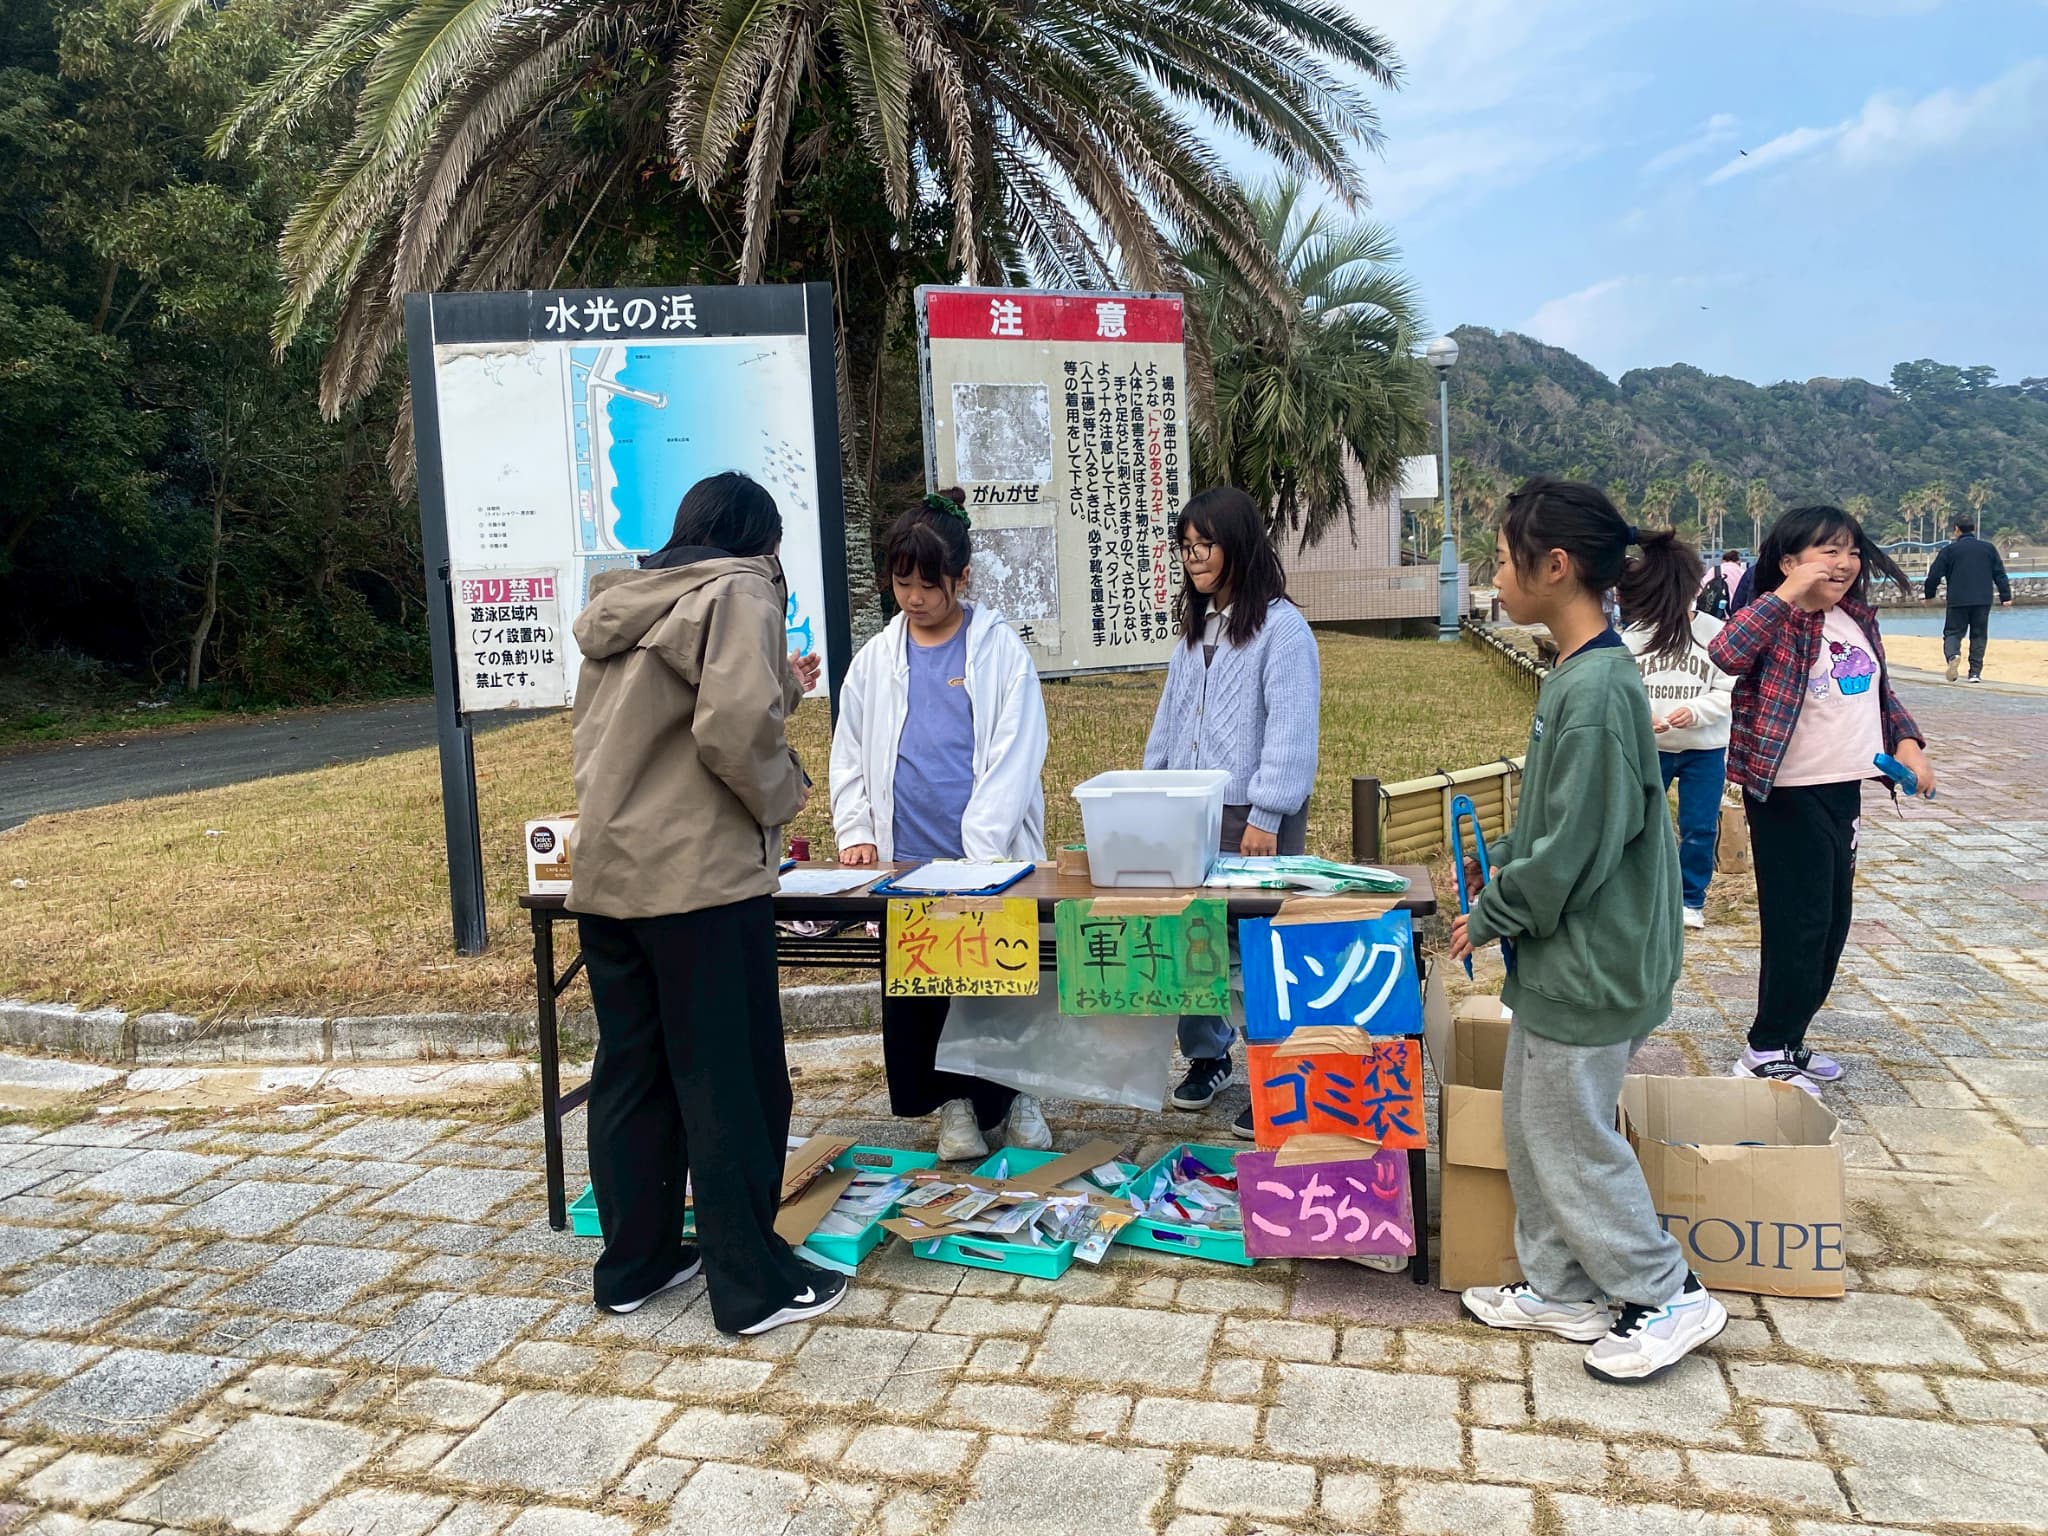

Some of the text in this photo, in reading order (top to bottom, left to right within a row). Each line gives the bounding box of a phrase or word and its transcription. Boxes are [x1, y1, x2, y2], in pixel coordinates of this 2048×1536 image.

[545, 294, 698, 334] 水光の浜
[1063, 361, 1086, 520] 等の着用をして下さい。
[973, 484, 1039, 503] がんがぜ
[1129, 361, 1155, 644] 人体に危害を及ぼす生物が生息しています。
[463, 578, 553, 603] 釣り禁止
[470, 605, 538, 622] 遊泳区域内
[472, 626, 554, 644] (ブイ設置内)
[474, 649, 554, 665] での魚釣りは
[475, 672, 536, 688] 禁止です。
[898, 926, 990, 977] 受付
[1080, 921, 1174, 984] 軍手
[1271, 926, 1409, 1026] トング
[1263, 1059, 1419, 1141] ゴミ袋
[1252, 1173, 1412, 1248] こちらへ
